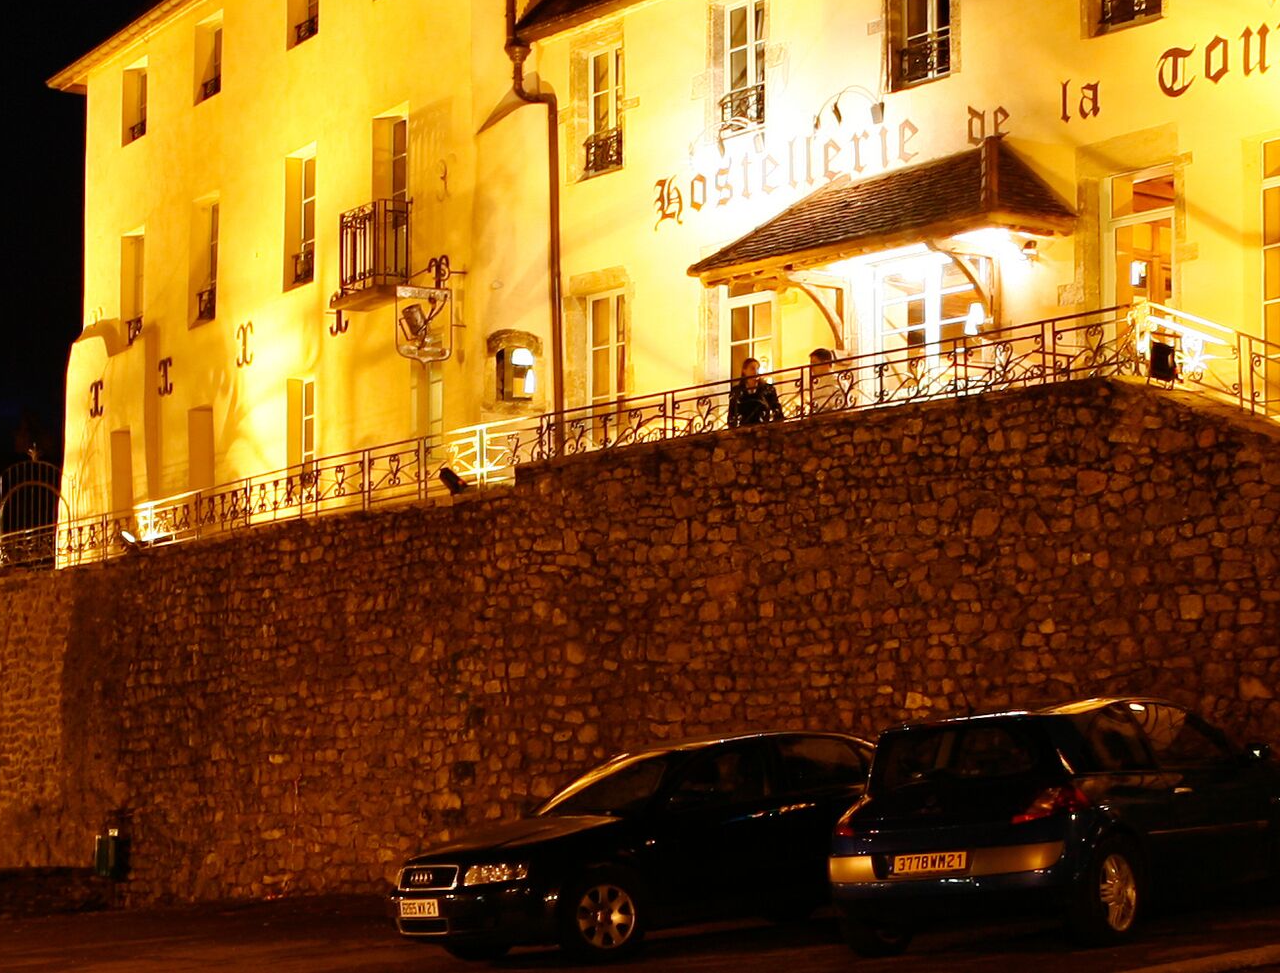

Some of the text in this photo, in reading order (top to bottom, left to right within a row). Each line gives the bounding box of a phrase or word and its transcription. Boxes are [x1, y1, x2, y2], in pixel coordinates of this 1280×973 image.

[654, 119, 920, 229] Hostellerie
[967, 105, 1011, 147] de
[1060, 79, 1101, 124] la
